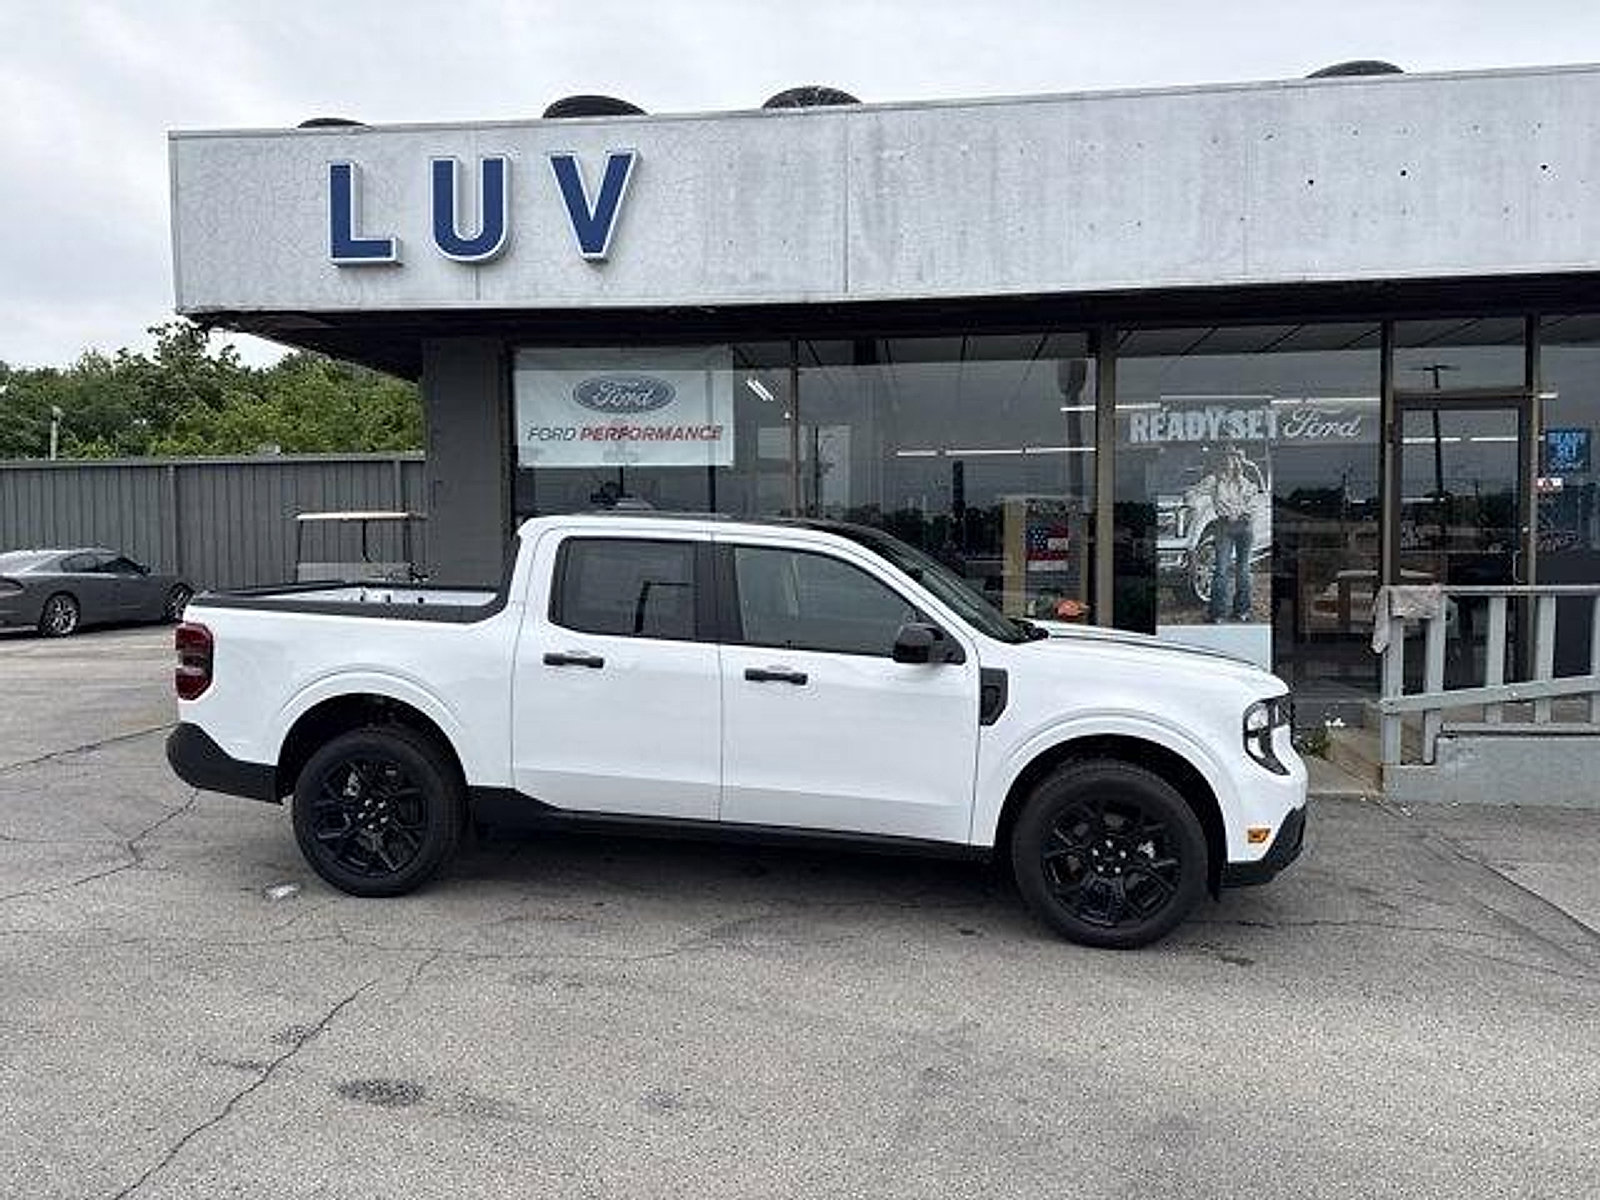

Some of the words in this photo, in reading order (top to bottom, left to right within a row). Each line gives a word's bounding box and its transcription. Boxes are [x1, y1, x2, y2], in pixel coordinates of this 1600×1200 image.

[329, 151, 637, 263] LUV
[591, 380, 654, 407] Ford
[528, 427, 576, 441] FORD
[580, 425, 723, 441] PERFORMANCE
[1129, 406, 1225, 443] READY
[1227, 406, 1279, 439] SET
[1283, 407, 1362, 438] Ford
